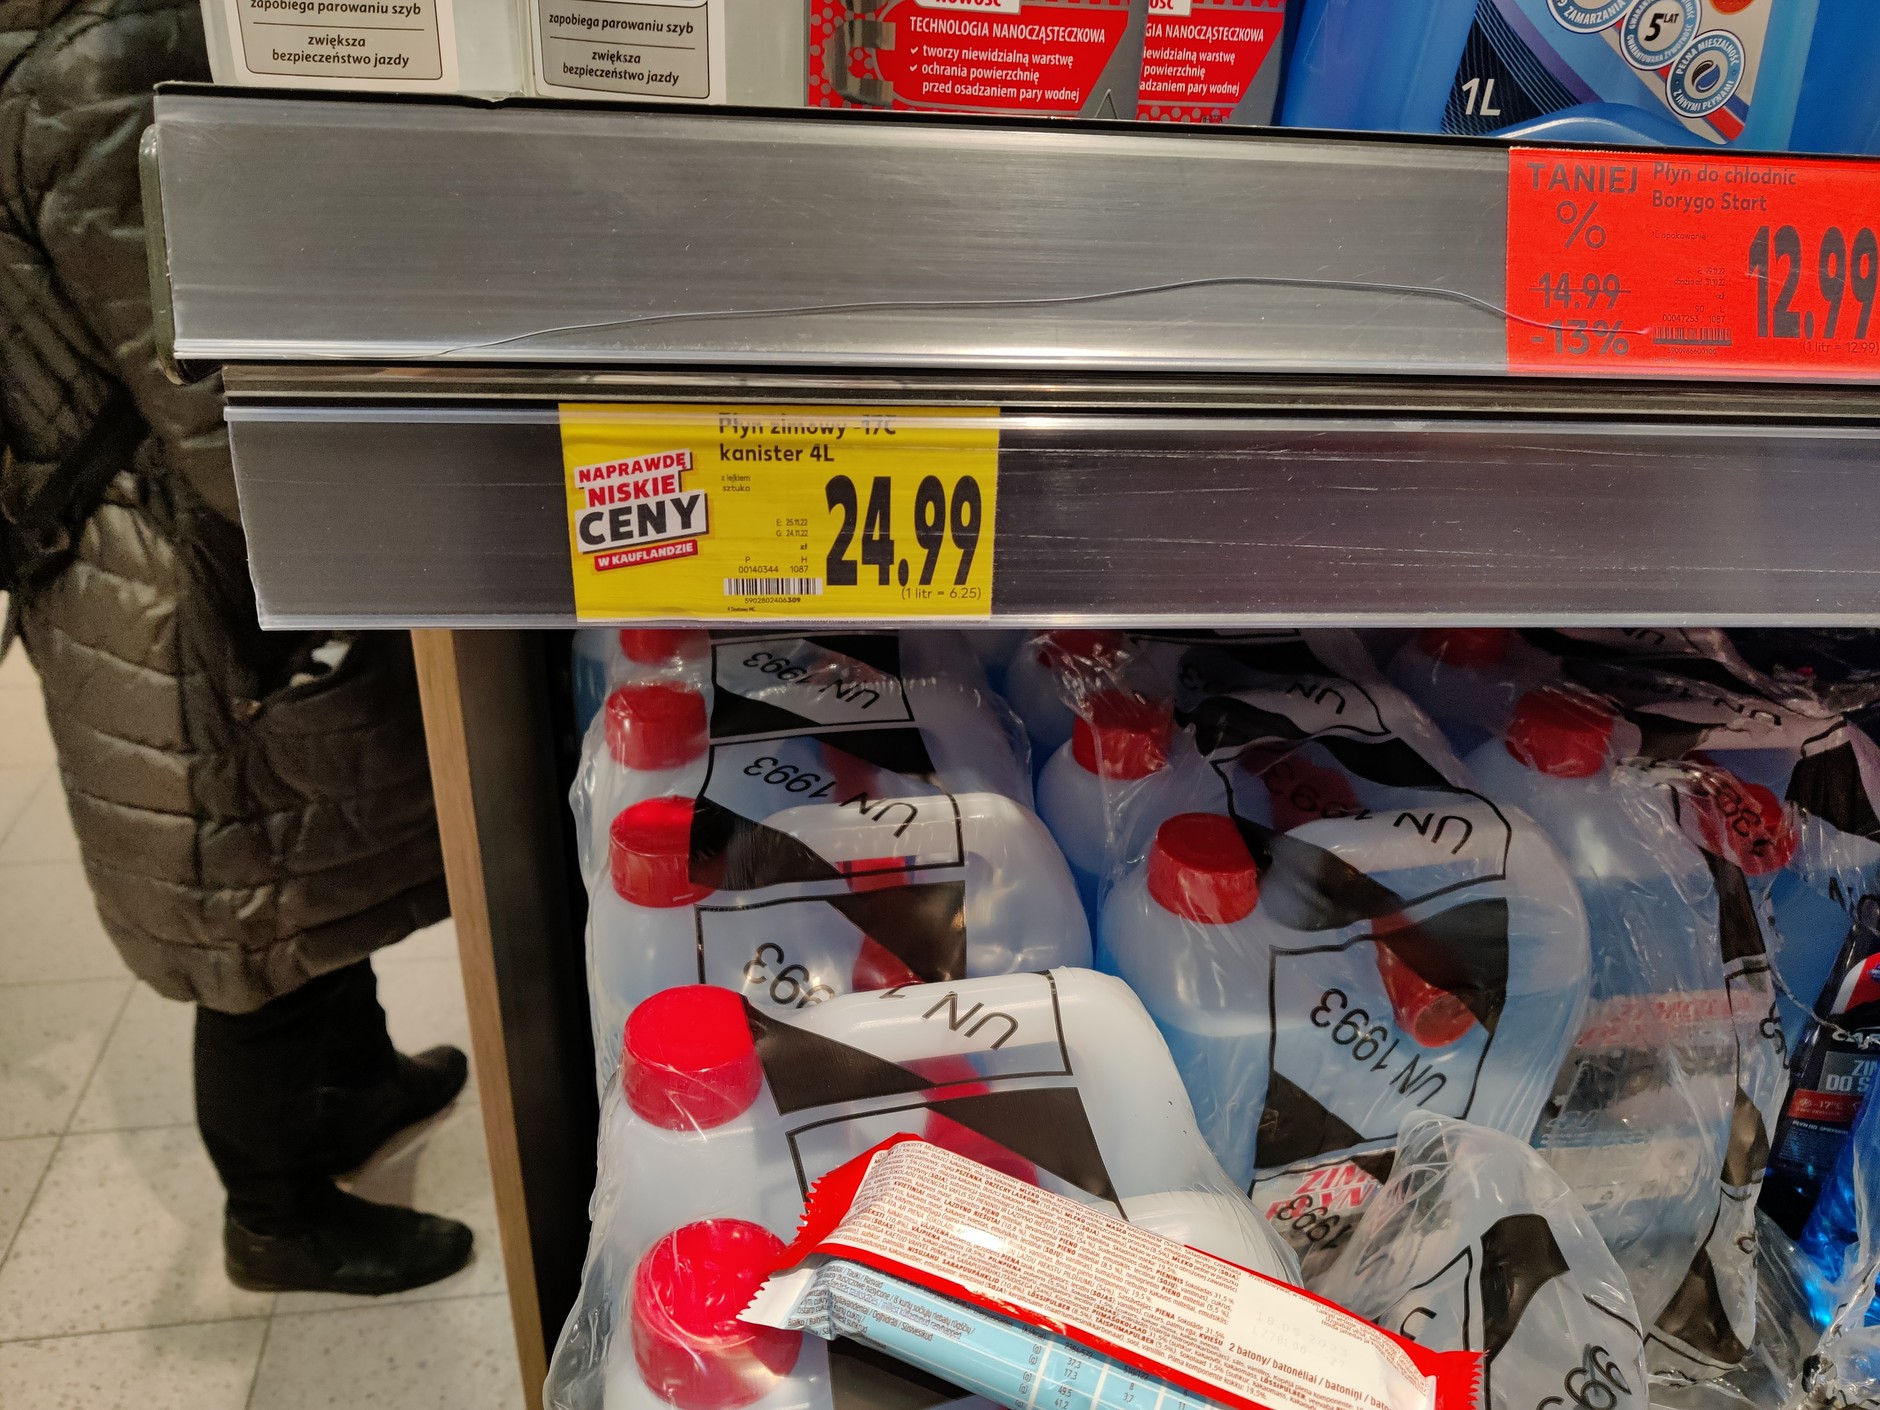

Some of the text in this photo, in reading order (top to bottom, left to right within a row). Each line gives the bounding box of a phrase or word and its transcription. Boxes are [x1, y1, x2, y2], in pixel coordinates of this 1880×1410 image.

[251, 0, 421, 17] zapobiega parowaniu szyb
[1564, 0, 1625, 24] ZAMARZANIA
[549, 14, 693, 36] zapobiega parowaniu szyb
[910, 17, 1105, 44] TECHNOLOGIA NANOCZĄSTECZKOWA
[1166, 24, 1263, 43] NANOCZĄSTECZKOWA
[1644, 13, 1679, 42] 5 LAT
[308, 35, 365, 49] zwiększa
[272, 50, 409, 68] bezpieczeństwo jazdy
[592, 50, 641, 65] zwiększa
[923, 45, 1073, 69] tworzy niewidzialną warstwę
[1200, 51, 1235, 65] warstwę
[1677, 38, 1740, 75] PEŁNA MIESZALNOŚĆ
[563, 63, 679, 86] bezpieczeństwo jazdy
[922, 62, 1039, 84] ochrania powierzchnię
[1144, 64, 1206, 79] powierzchnię
[923, 81, 1080, 103] przed osadzaniem pary wodnej
[1188, 83, 1207, 95] pary
[1210, 82, 1240, 97] wodnej
[1461, 77, 1502, 117] 1L
[1675, 91, 1701, 112] INNYMI
[1702, 80, 1735, 111] PŁYNAMI
[1528, 162, 1638, 193] TANIEJ
[1653, 162, 1796, 186] Płyn do chłodnic
[1651, 190, 1767, 213] Borygo Start
[1556, 200, 1607, 249] %
[1538, 272, 1621, 310] 14.99
[1748, 225, 1878, 340] 12.99
[1530, 319, 1629, 356] -13%
[1814, 343, 1831, 352] litr
[1846, 342, 1879, 355] 12.99)
[719, 412, 763, 439] Płyn
[770, 413, 846, 439] zimowy
[720, 443, 835, 462] kanister 4L
[579, 452, 687, 483] NAPRAWDĘ
[727, 474, 750, 483] lejkiem
[588, 474, 676, 508] NISKIE
[579, 494, 700, 545] CENY
[825, 474, 981, 587] 24.99
[598, 543, 693, 567] W KAUFLANDZIE
[790, 565, 808, 573] 1087
[902, 587, 911, 600] (1
[915, 588, 932, 599] litr
[949, 587, 981, 600] 6.25)
[818, 677, 881, 710] UN
[743, 755, 919, 839] UN 1993
[1393, 812, 1472, 856] UN
[922, 990, 1018, 1051] UN
[1310, 988, 1447, 1107] UN 1993
[980, 1206, 1078, 1248] PIENO PIENO
[1277, 1194, 1352, 1250] 1993
[943, 1198, 972, 1214] LAZDYNO
[1056, 1243, 1076, 1255] PIENO
[1160, 1285, 1181, 1297] PIENO
[1064, 1212, 1085, 1223] MLEKO
[1171, 1255, 1193, 1268] MLEKO
[1000, 1253, 1020, 1265] PIENA
[1155, 1269, 1184, 1284] PIENINIS
[1154, 1307, 1176, 1319] PIENA
[1227, 1342, 1235, 1351] 2
